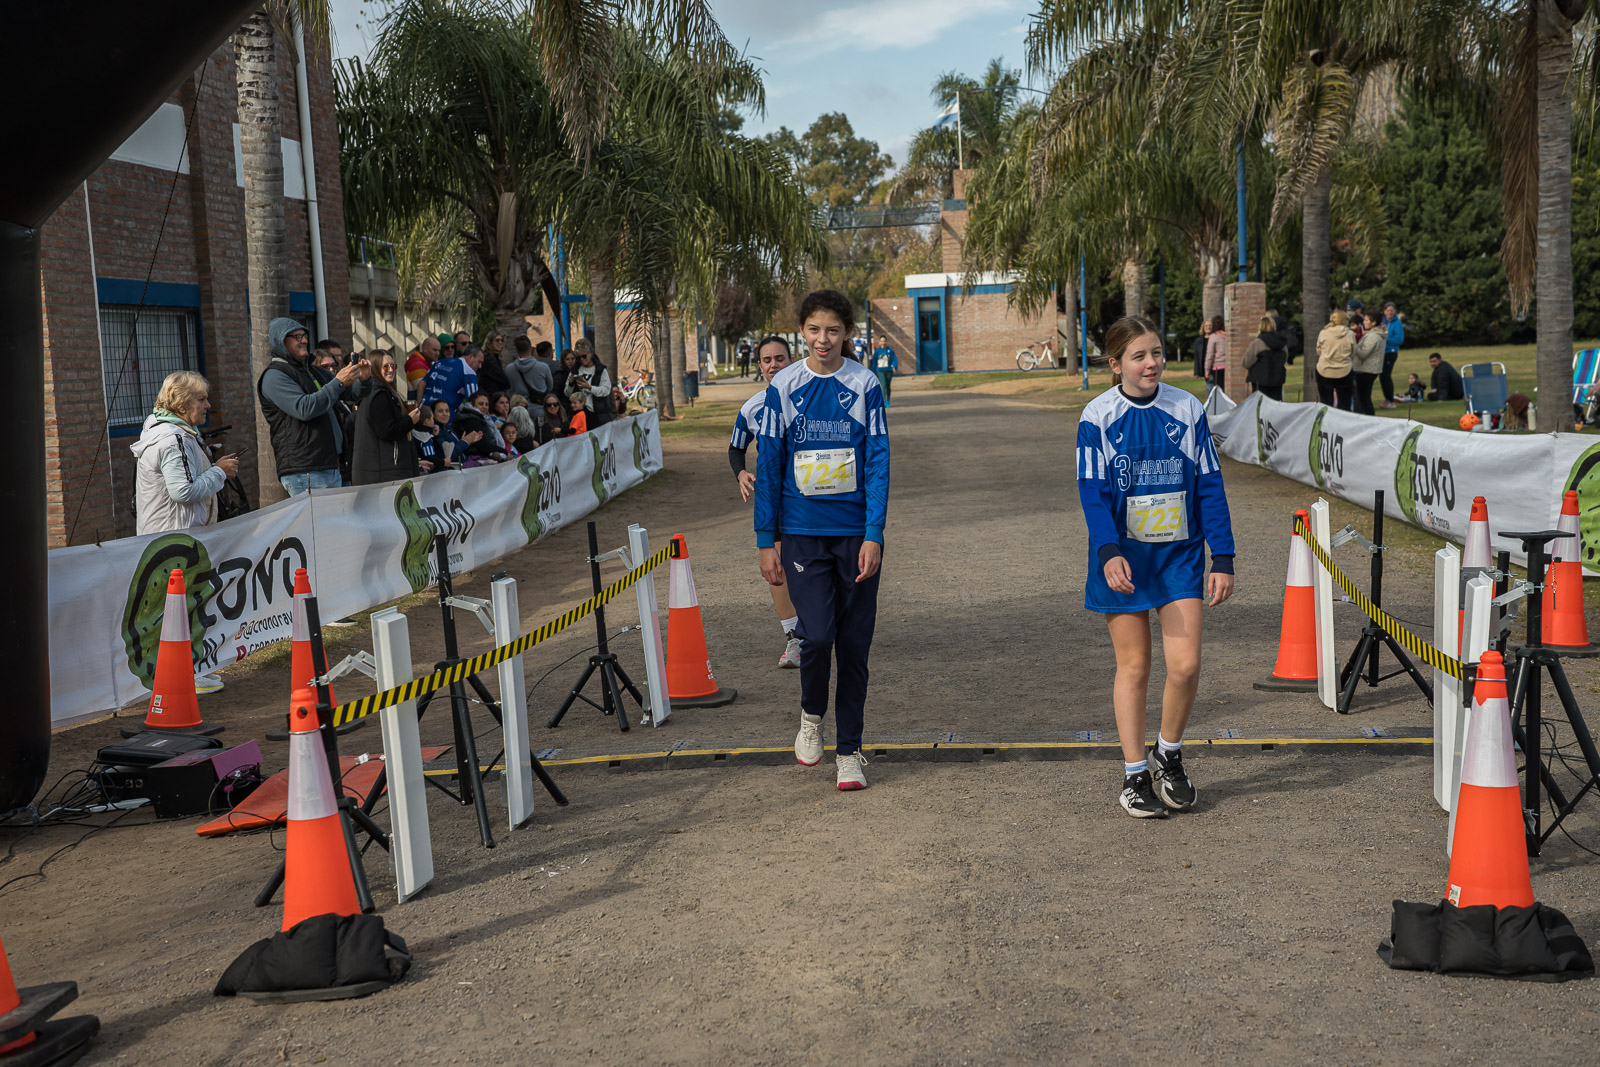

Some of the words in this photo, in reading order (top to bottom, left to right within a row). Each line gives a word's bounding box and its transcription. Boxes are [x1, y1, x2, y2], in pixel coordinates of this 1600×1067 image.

[794, 414, 806, 443] 3
[800, 462, 850, 485] 724
[1114, 454, 1131, 491] 3
[1132, 456, 1183, 476] MARATÓN
[1135, 506, 1182, 532] 723
